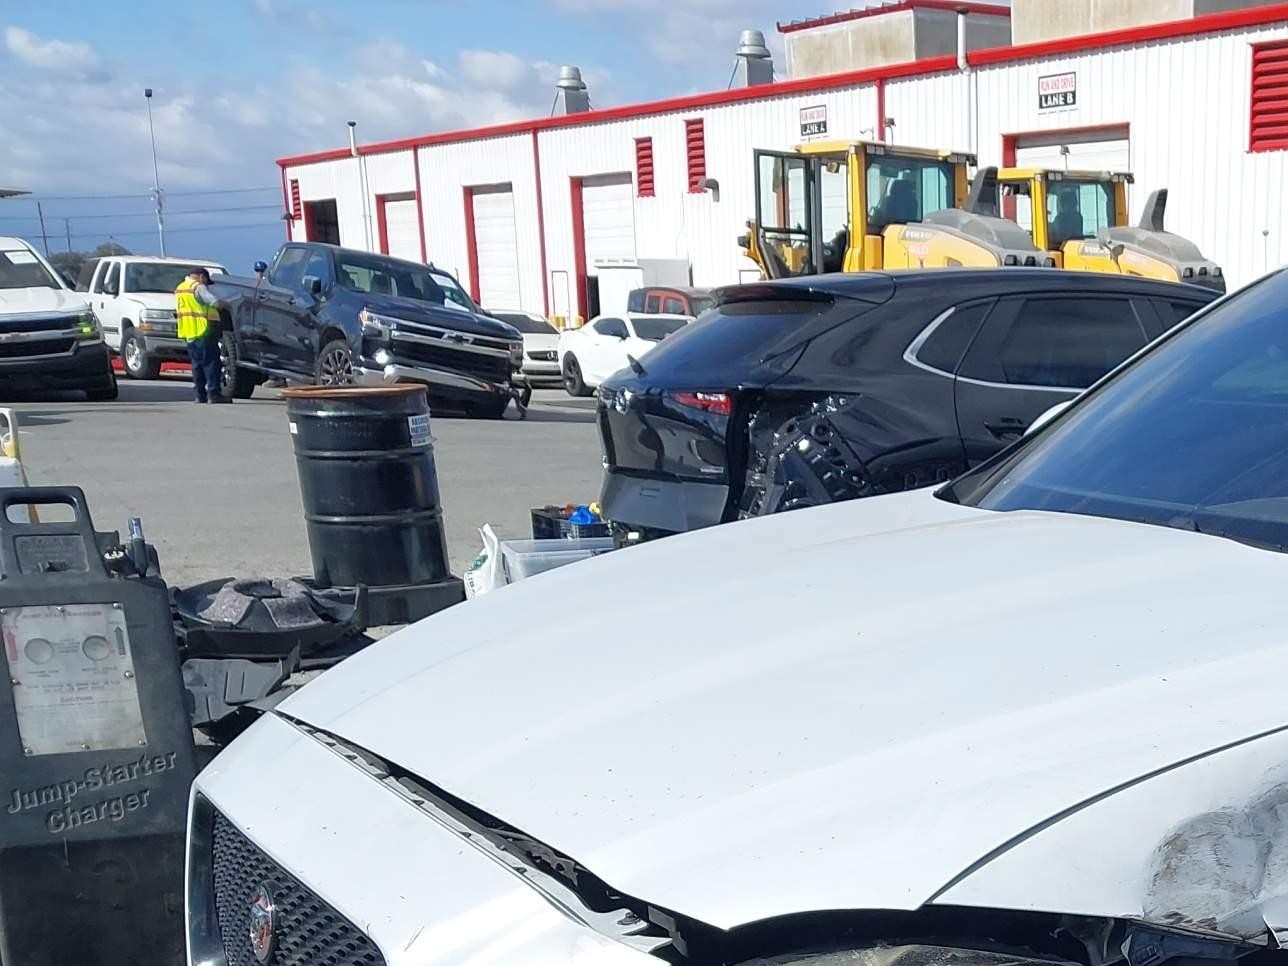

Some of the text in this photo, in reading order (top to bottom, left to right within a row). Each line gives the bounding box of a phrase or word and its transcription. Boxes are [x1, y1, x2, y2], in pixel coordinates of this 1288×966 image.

[1041, 92, 1073, 107] LANE B
[7, 751, 177, 814] Jump-Starter
[46, 790, 151, 833] Charger
